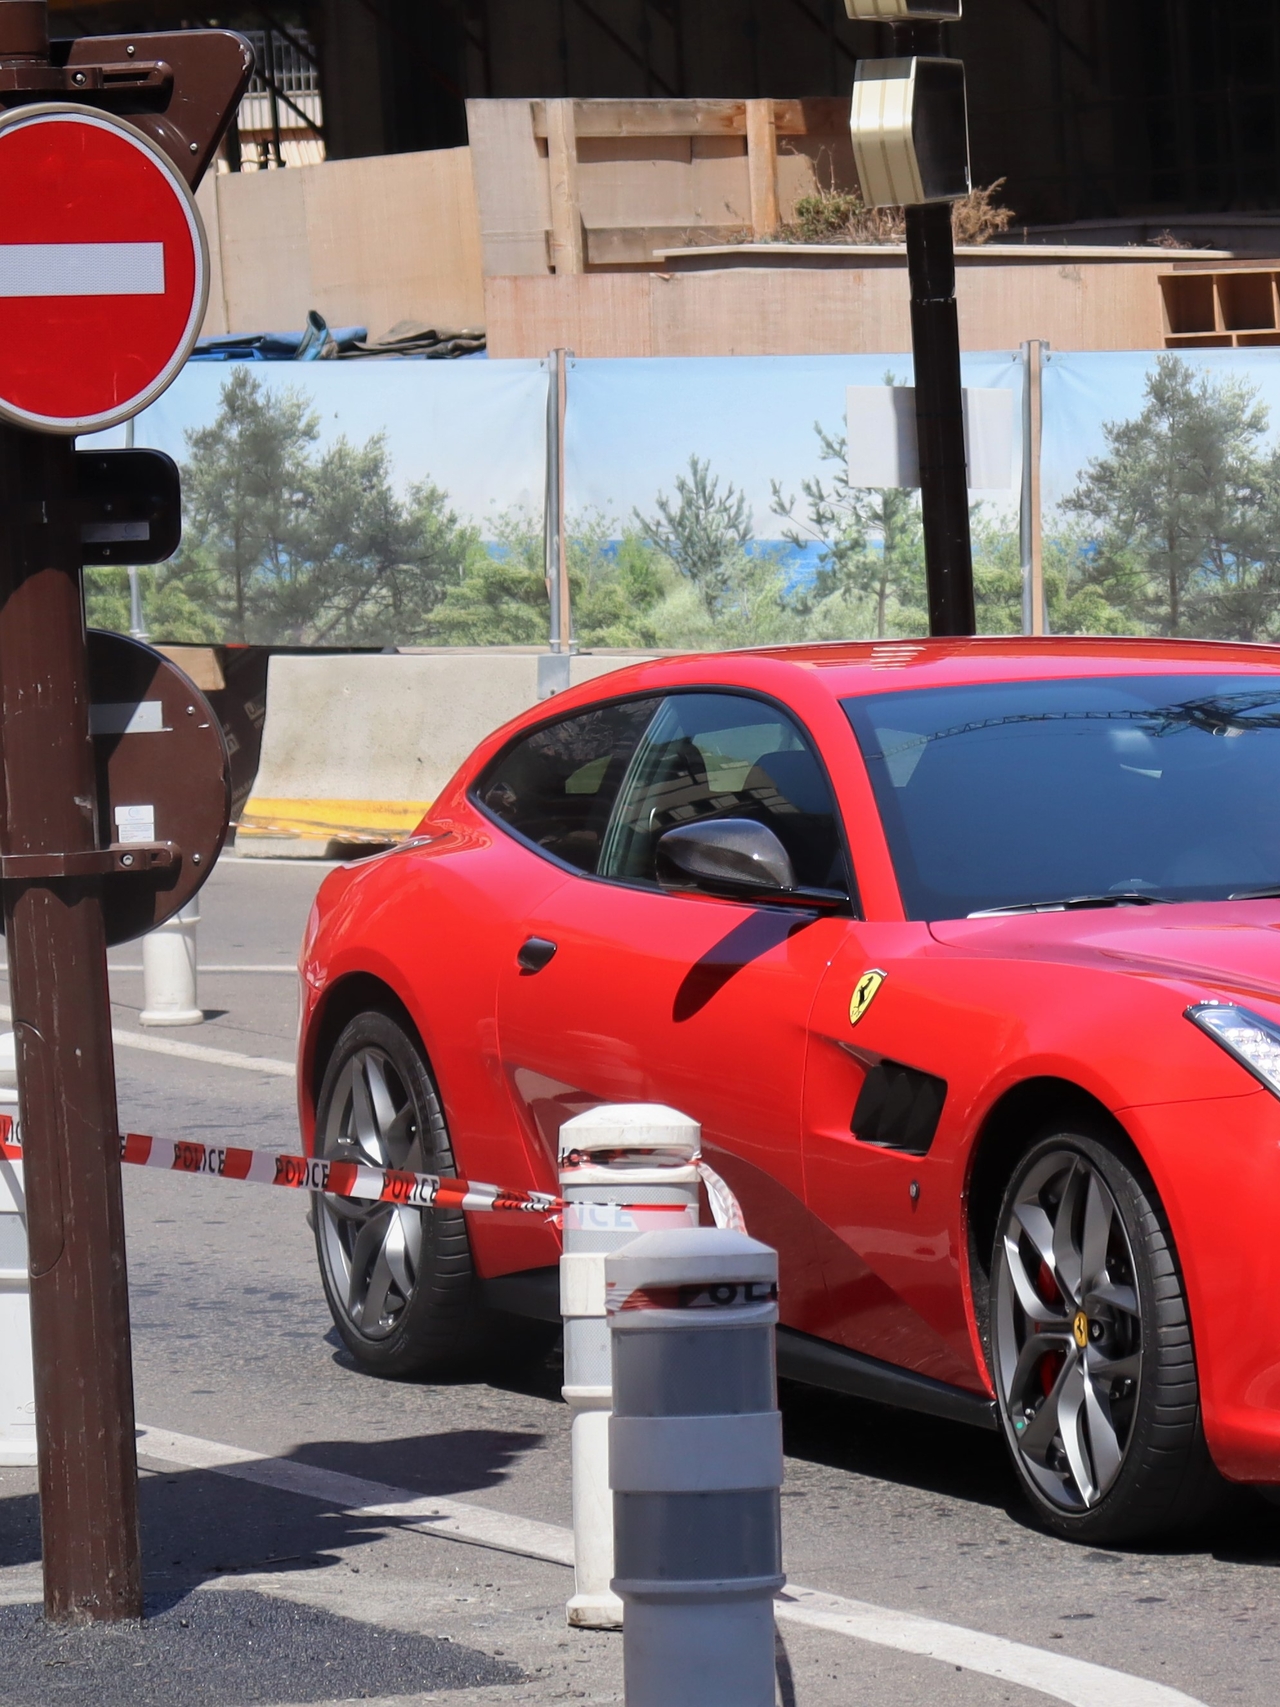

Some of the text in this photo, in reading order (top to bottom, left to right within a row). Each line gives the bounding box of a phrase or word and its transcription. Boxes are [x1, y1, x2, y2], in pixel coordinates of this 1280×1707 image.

[174, 1143, 438, 1204] POLICE POLICE POLICE
